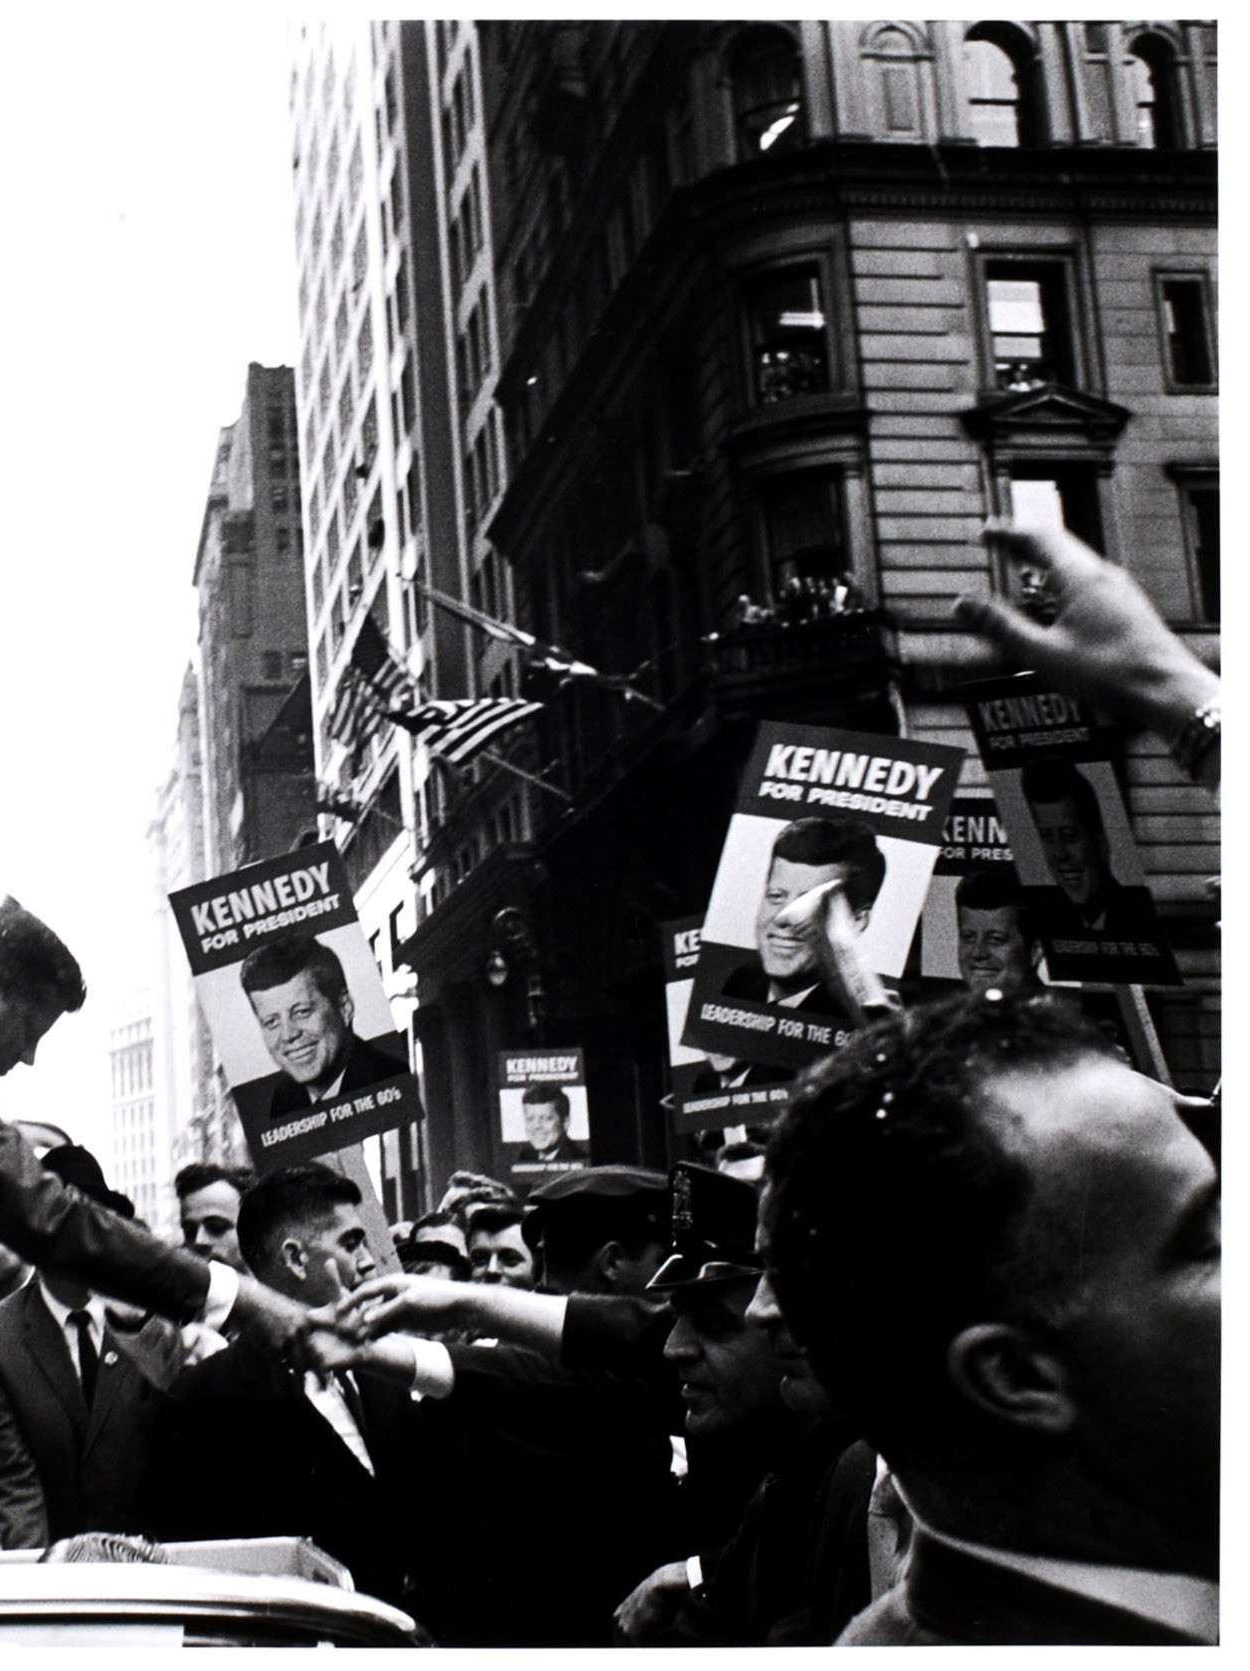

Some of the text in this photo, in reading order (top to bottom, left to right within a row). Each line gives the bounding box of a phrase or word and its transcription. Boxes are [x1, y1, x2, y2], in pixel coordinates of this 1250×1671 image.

[764, 743, 945, 800] KENNEDY
[758, 780, 934, 822] FOR PRESIDENT
[190, 860, 331, 936] KENNEDY
[200, 893, 340, 954] FOR PRESIDENT
[700, 1003, 776, 1032] LEADERSHIP
[777, 1018, 804, 1039] FOR
[806, 1024, 833, 1045] THE
[506, 1056, 578, 1075] KENNEDY
[261, 1111, 328, 1147] LEADERSHIP
[330, 1103, 354, 1123] FOR
[353, 1094, 376, 1114] THE
